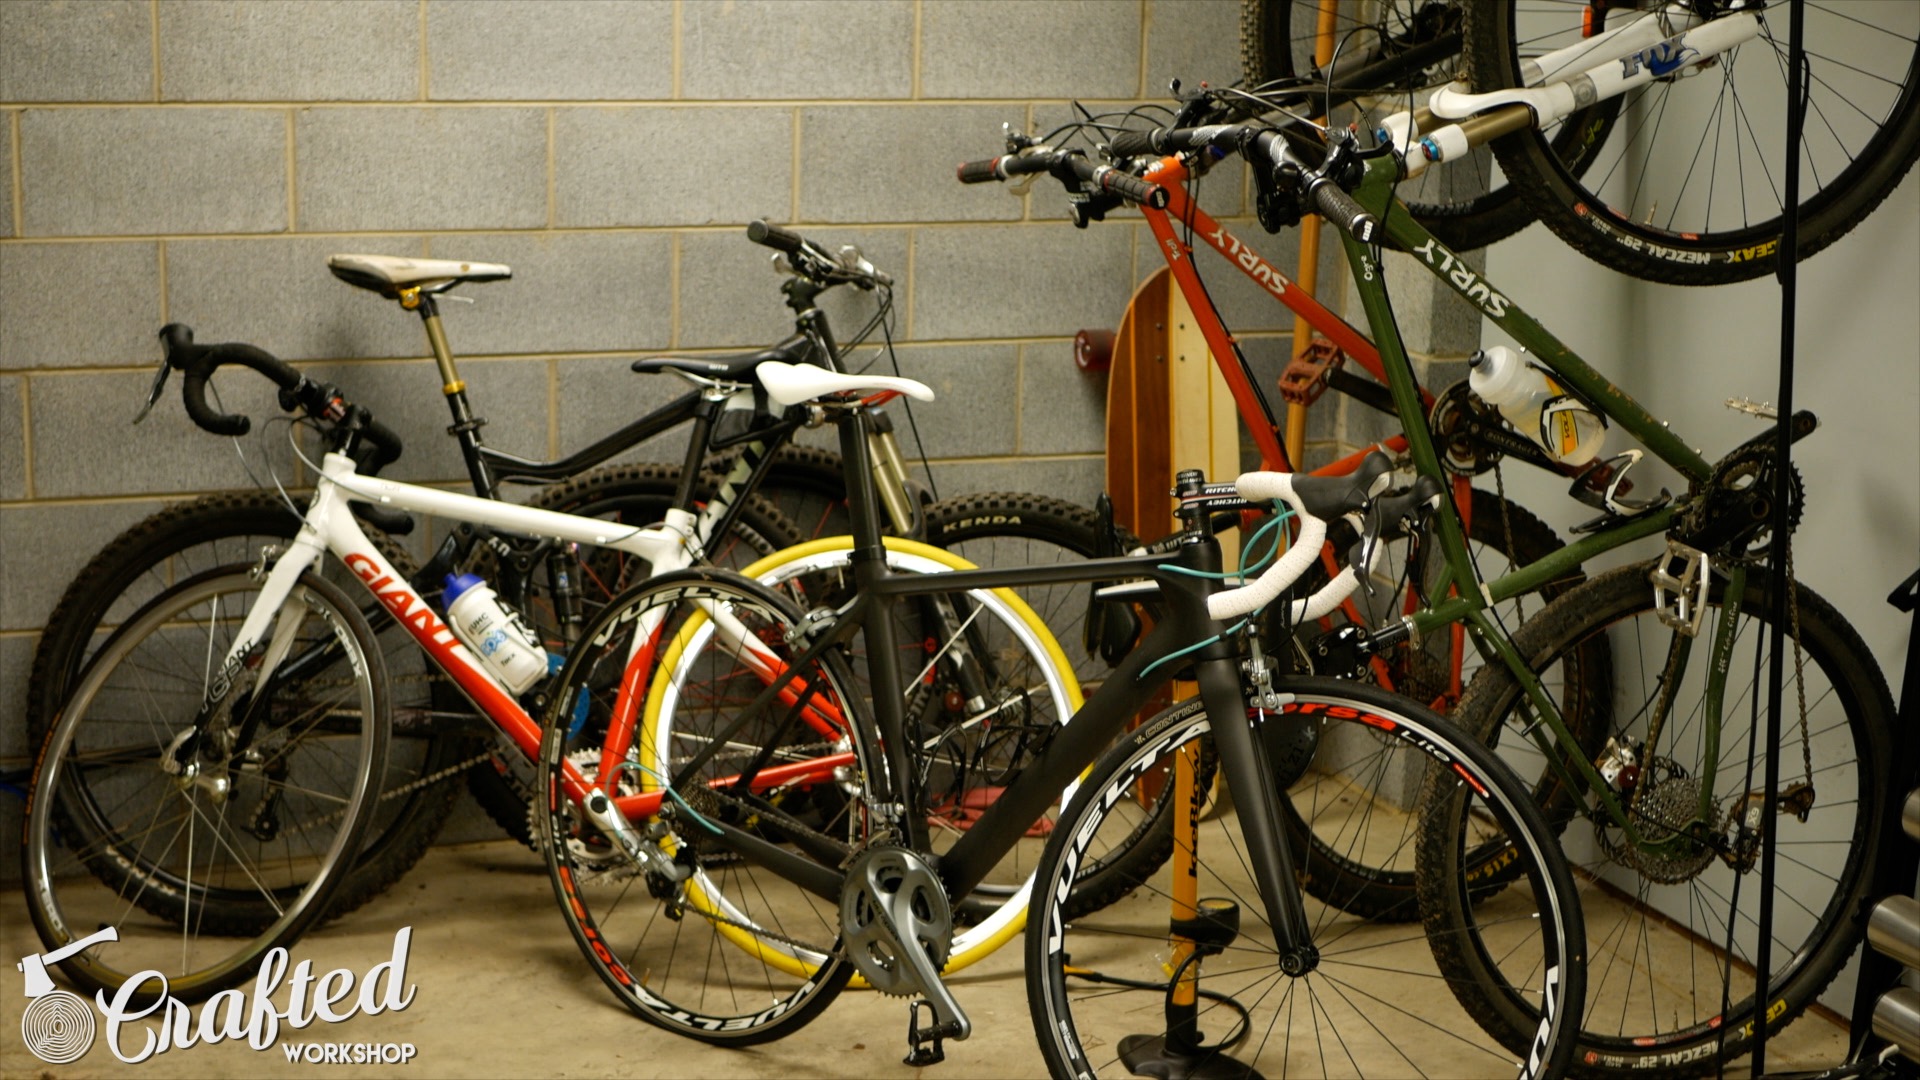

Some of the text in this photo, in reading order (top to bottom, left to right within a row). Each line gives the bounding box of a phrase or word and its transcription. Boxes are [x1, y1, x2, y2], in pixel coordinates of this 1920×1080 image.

[1620, 33, 1688, 79] FOX
[1208, 229, 1289, 294] SURLY
[1361, 255, 1373, 281] Ogre
[1413, 239, 1510, 317] SURLY
[1647, 243, 1711, 265] MEZCAL
[943, 515, 1021, 534] KENDA
[344, 553, 463, 652] GIANT
[593, 586, 774, 647] VUELTA
[1049, 720, 1212, 955] VUELTA
[106, 845, 177, 896] KENDA
[634, 980, 816, 1031] VUELTA
